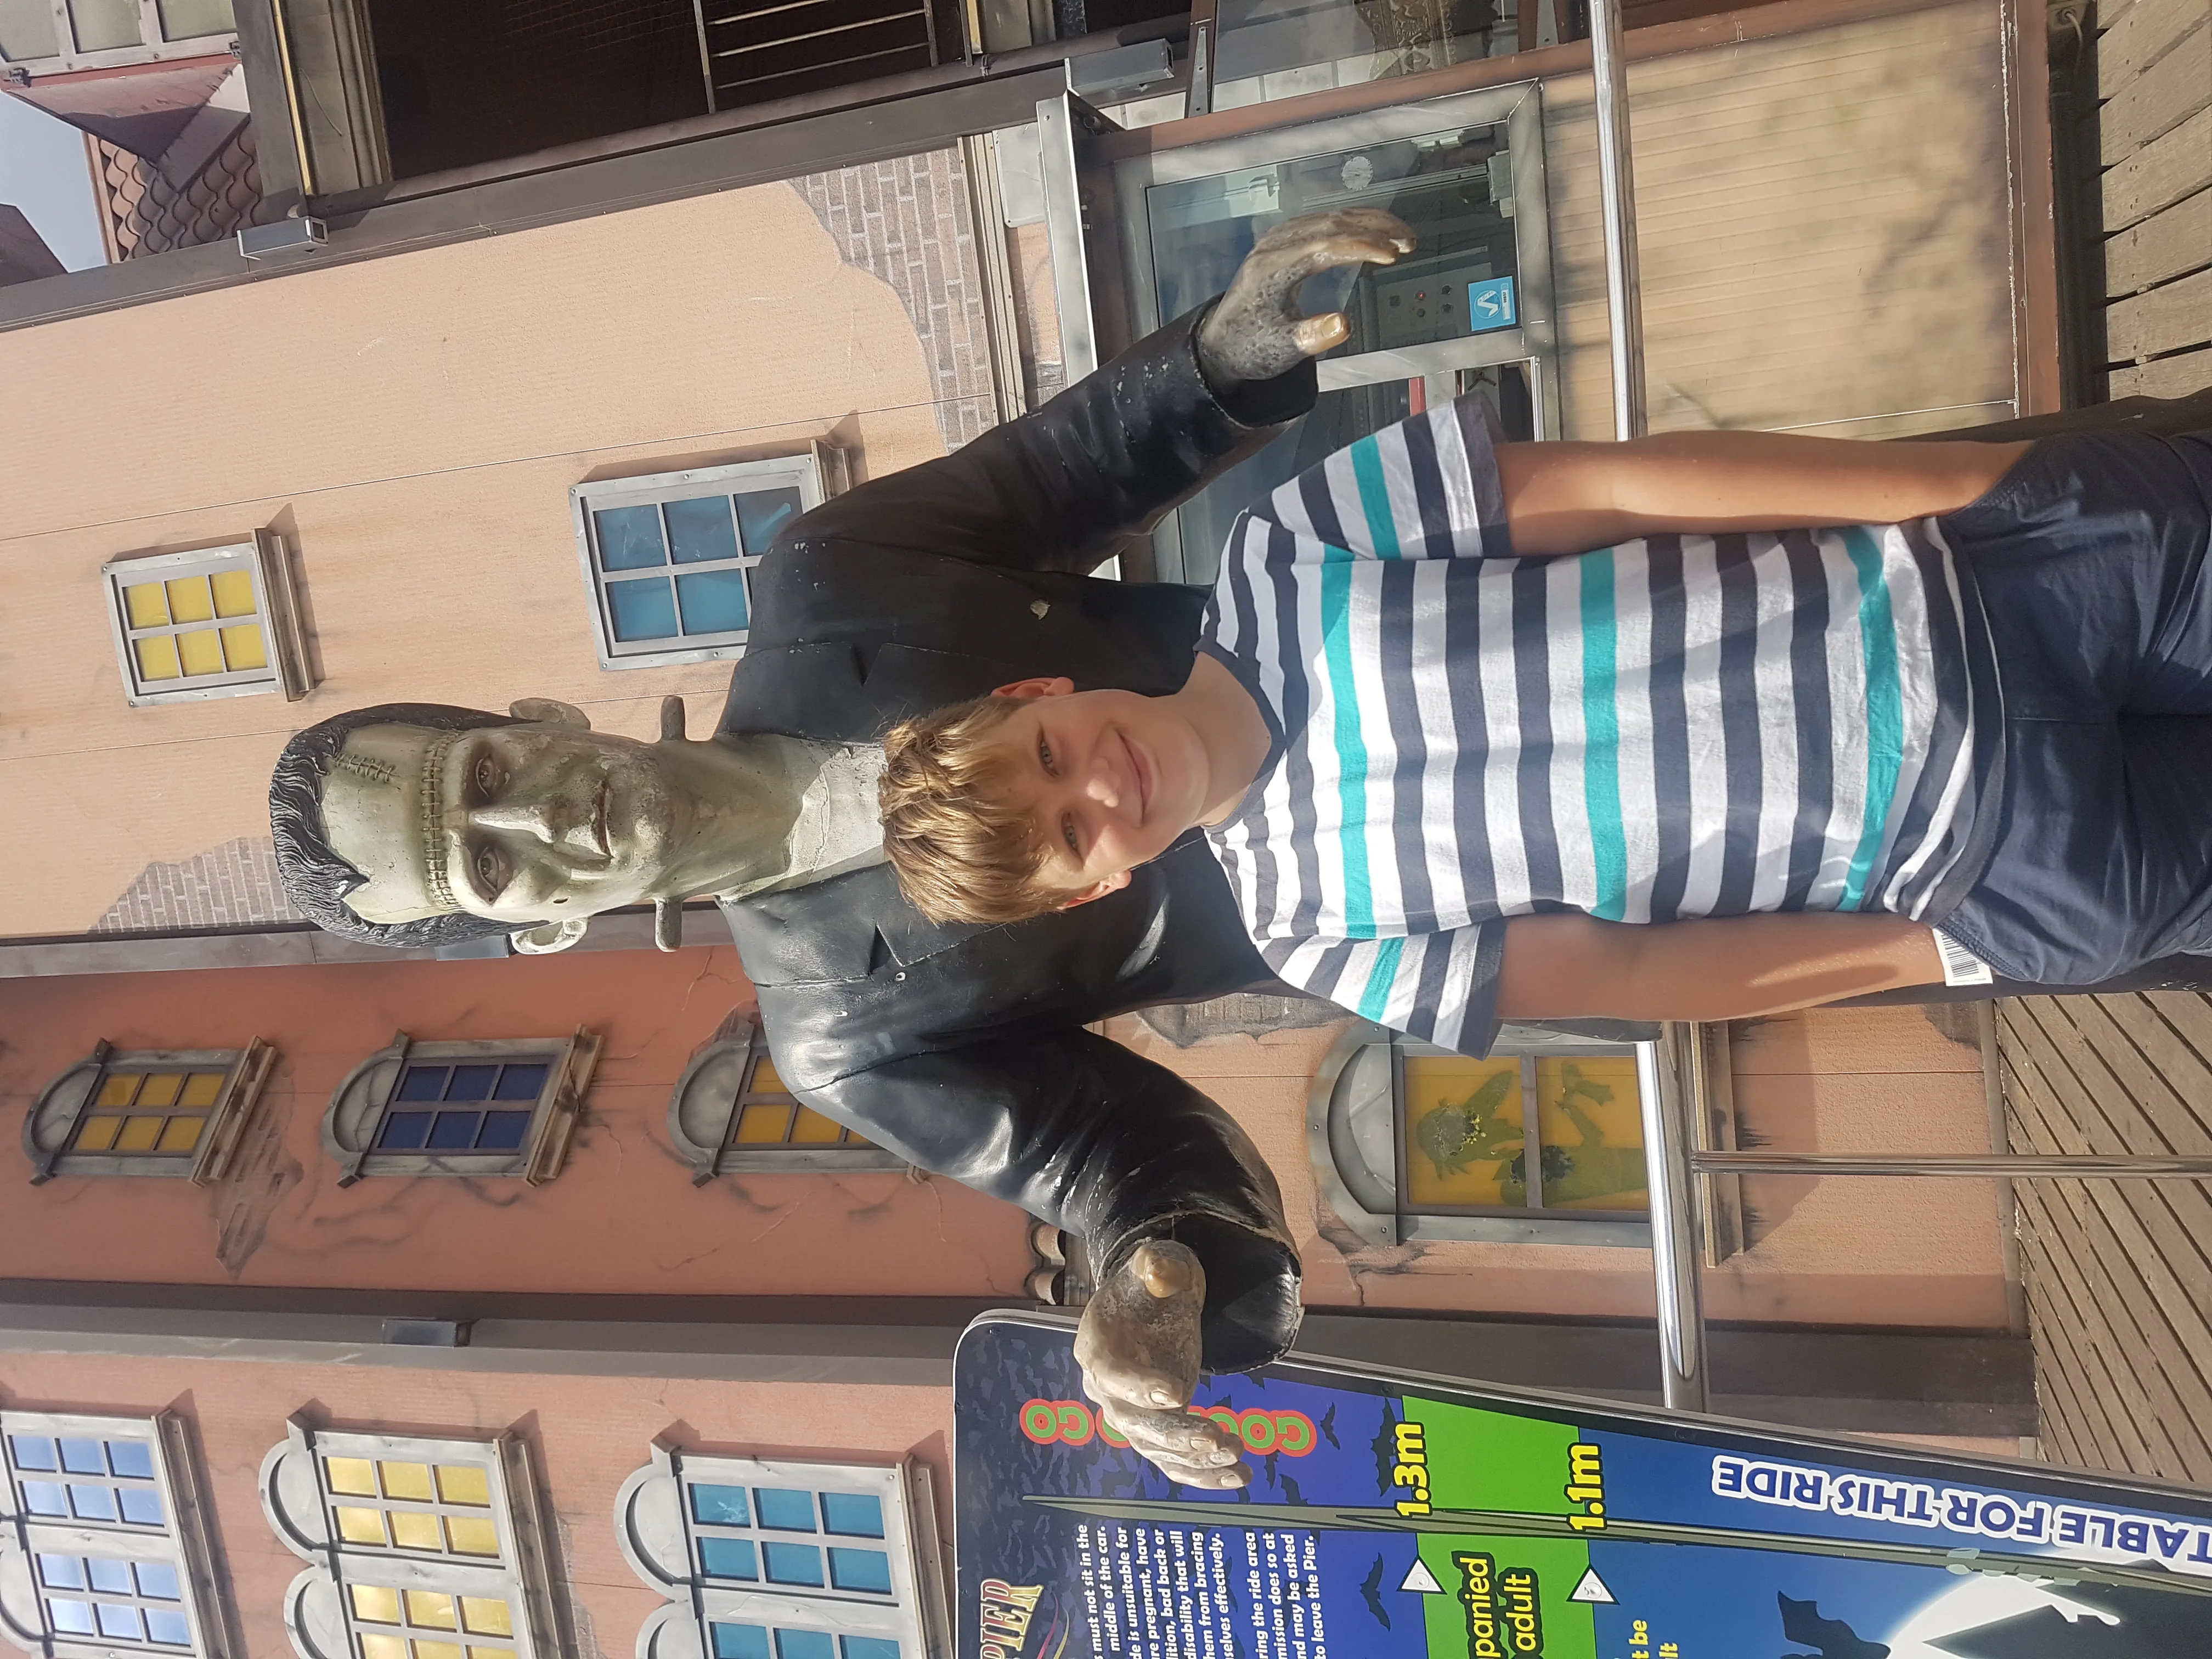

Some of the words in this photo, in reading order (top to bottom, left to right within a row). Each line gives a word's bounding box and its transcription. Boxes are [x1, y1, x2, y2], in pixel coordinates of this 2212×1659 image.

[1026, 1407, 1087, 1438] GO
[1187, 1411, 1308, 1449] GO
[1393, 1424, 1430, 1516] 1.3m
[1718, 1462, 1822, 1504] RIDE
[1567, 1445, 1604, 1530] 1.1m
[1835, 1481, 1931, 1520] THIS
[1948, 1496, 2043, 1536] FOR
[1076, 1524, 1090, 1549] the
[1097, 1526, 1108, 1554] car.
[1115, 1527, 1128, 1549] for
[1136, 1528, 1149, 1565] have
[1154, 1529, 1165, 1545] or
[1169, 1530, 1185, 1557] will
[1245, 1532, 1259, 1567] area
[1262, 1533, 1276, 1550] at
[2059, 1513, 2212, 1564] TABLE
[1079, 1552, 1092, 1566] in
[1098, 1556, 1111, 1581] the
[1153, 1548, 1170, 1585] back
[1190, 1532, 1207, 1588] bracing
[1267, 1553, 1278, 1568] so
[1280, 1534, 1298, 1579] asked
[1302, 1536, 1317, 1571] Pier.
[1081, 1569, 1094, 1589] sit
[1118, 1551, 1138, 1627] unsuitable
[1174, 1560, 1189, 1592] that
[1209, 1533, 1229, 1613] effectively.
[1246, 1570, 1262, 1599] ride
[1267, 1572, 1282, 1605] does
[1306, 1574, 1320, 1599] the
[1084, 1589, 1098, 1613] not
[1099, 1583, 1114, 1599] of
[1138, 1568, 1160, 1639] pregnant,
[1157, 1588, 1173, 1617] bad
[1286, 1582, 1301, 1601] be
[1198, 1592, 1212, 1627] from
[1251, 1602, 1265, 1627] the
[1291, 1604, 1305, 1637] may
[1311, 1602, 1324, 1642] leave
[1460, 1557, 1501, 1659] panied
[1504, 1574, 1536, 1651] adult
[1087, 1617, 1103, 1652] must
[1103, 1602, 1120, 1651] middle
[1127, 1630, 1140, 1641] is
[1179, 1595, 1197, 1659] disability
[1219, 1617, 1234, 1659] selves
[1628, 1620, 1649, 1645] be
[1128, 1644, 1142, 1659] de
[1314, 1645, 1327, 1659] to
[1658, 1643, 1678, 1659] lt
